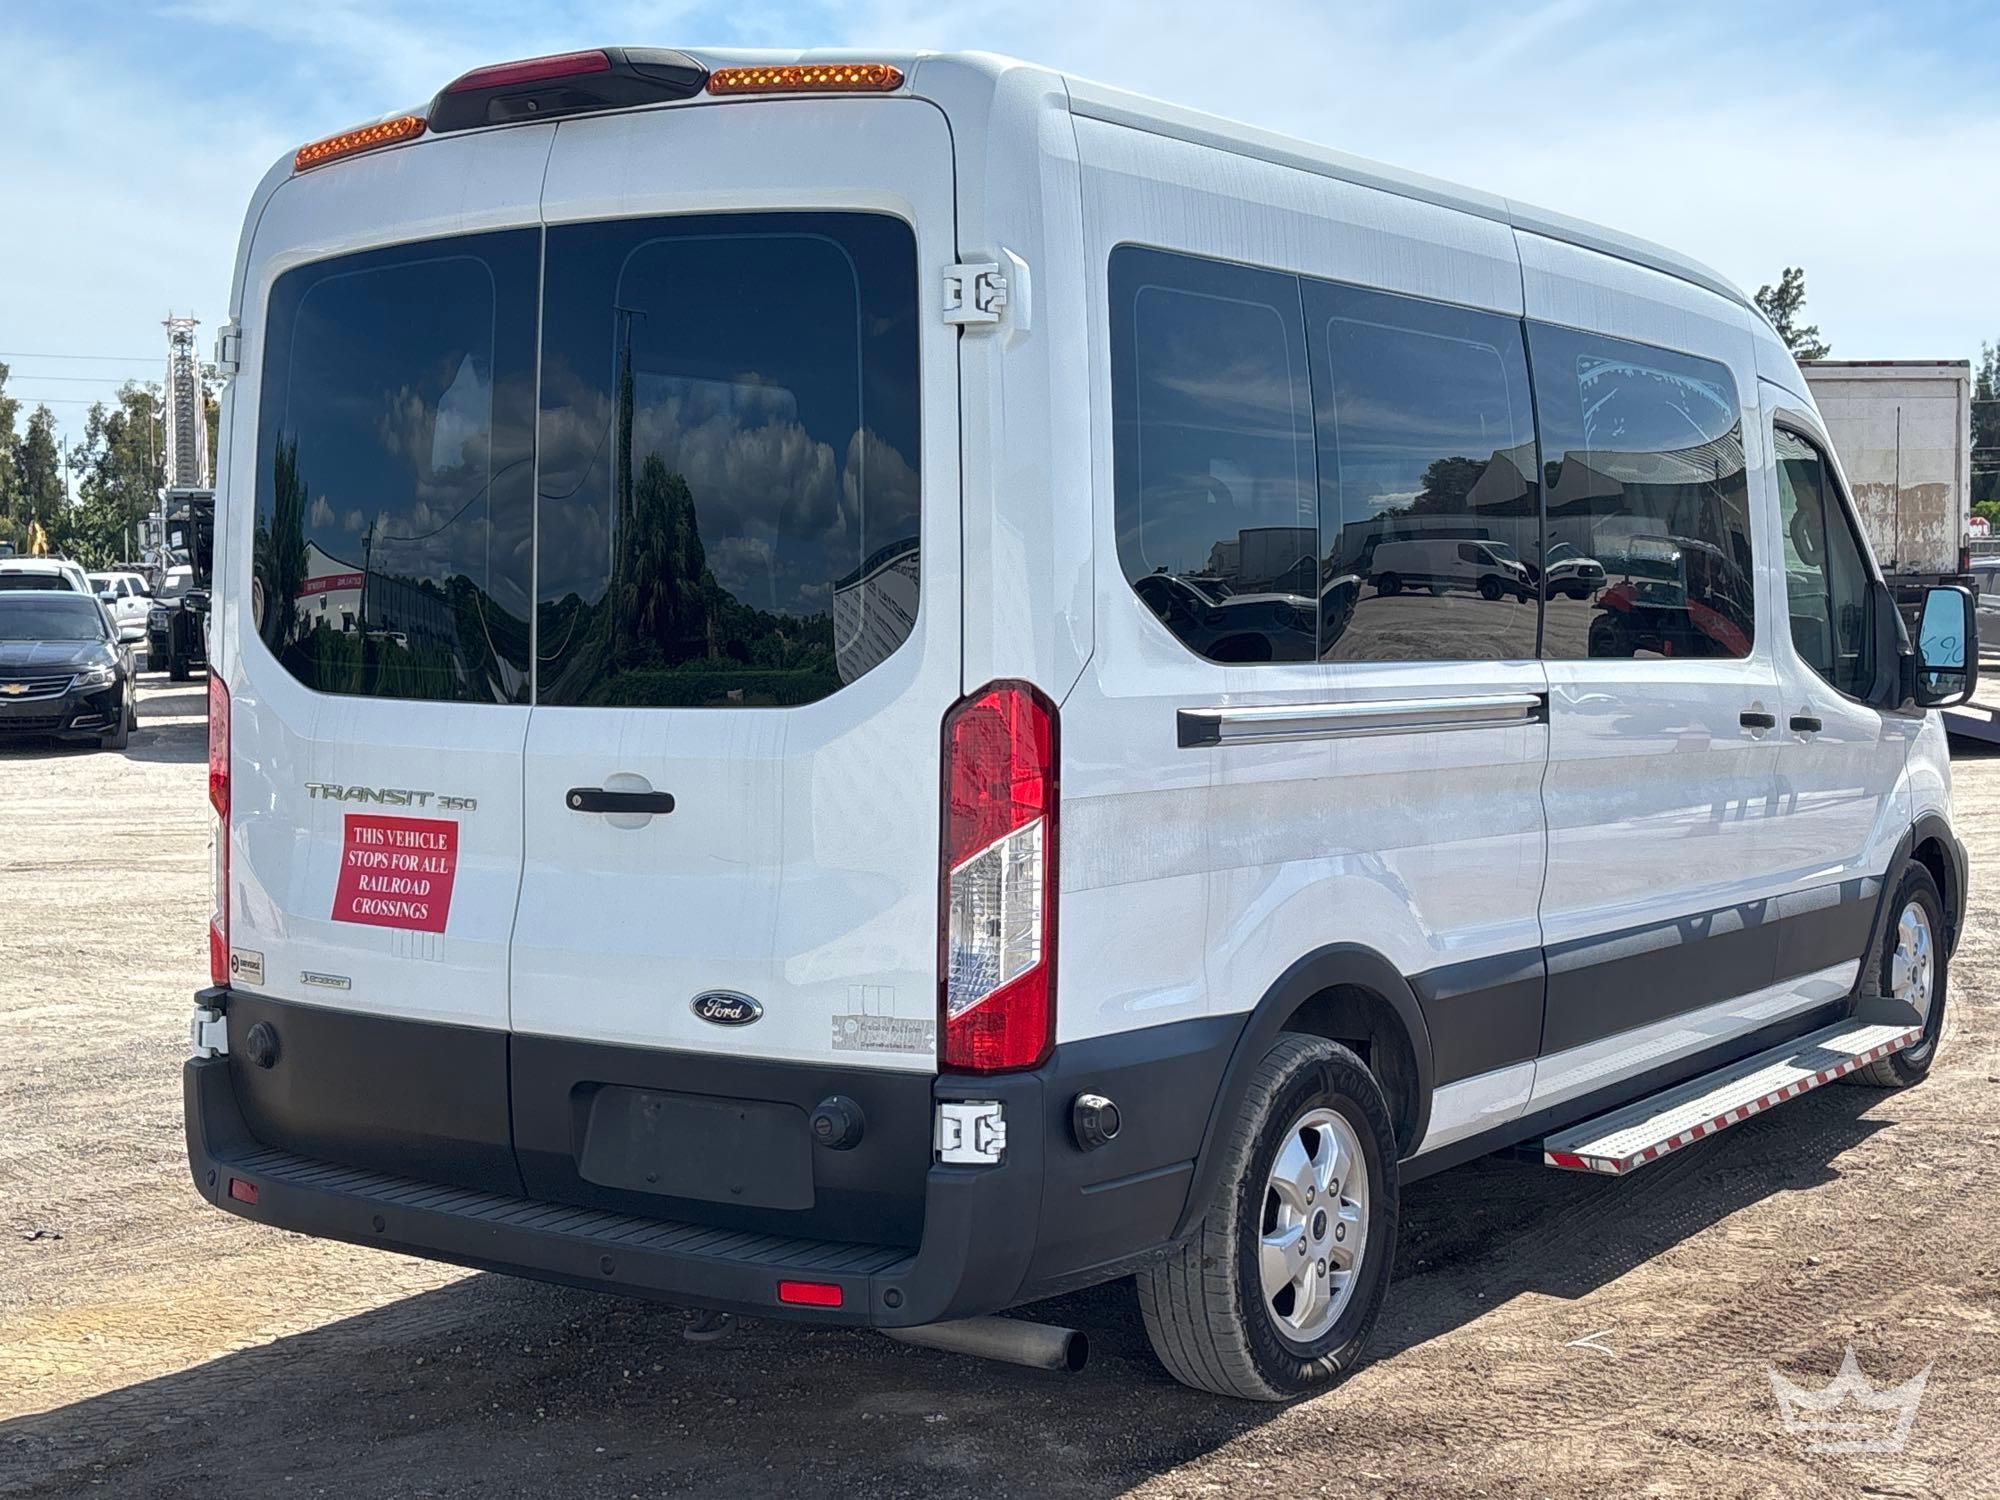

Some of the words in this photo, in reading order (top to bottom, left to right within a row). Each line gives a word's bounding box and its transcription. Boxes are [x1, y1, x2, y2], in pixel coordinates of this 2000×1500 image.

[305, 783, 434, 806] TRANSIT
[438, 796, 477, 811] 350
[354, 827, 384, 845] THIS
[386, 830, 447, 850] VEHICLE
[348, 850, 388, 869] STOPS
[391, 854, 418, 872] FOR
[421, 858, 448, 874] ALL
[358, 875, 430, 896] RAILROAD
[352, 897, 428, 920] CROSSINGS
[703, 997, 744, 1019] Ford
